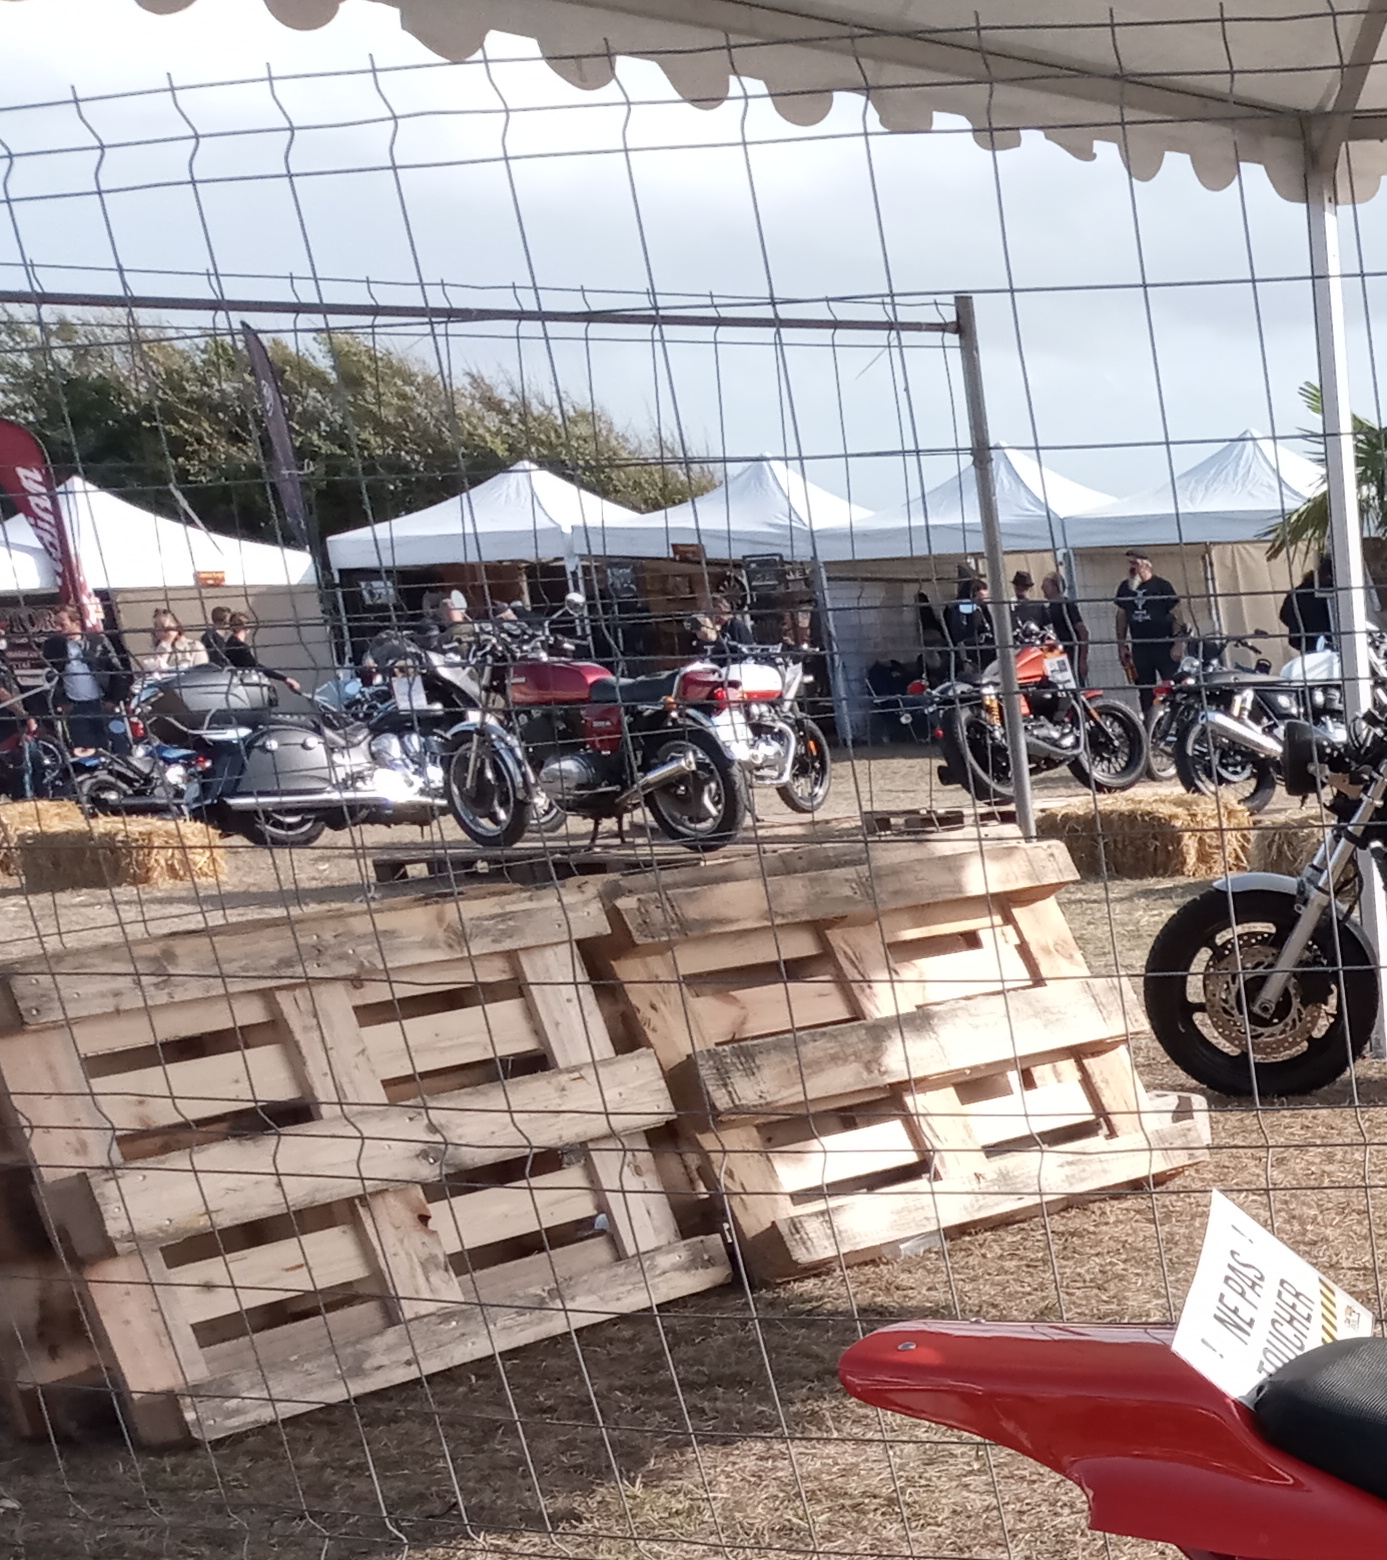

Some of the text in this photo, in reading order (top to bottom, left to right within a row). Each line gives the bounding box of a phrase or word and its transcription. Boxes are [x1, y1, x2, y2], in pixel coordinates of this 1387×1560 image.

[1223, 1249, 1266, 1311] PAS
[1213, 1292, 1256, 1346] NE
[1257, 1278, 1315, 1378] TOUCHER
